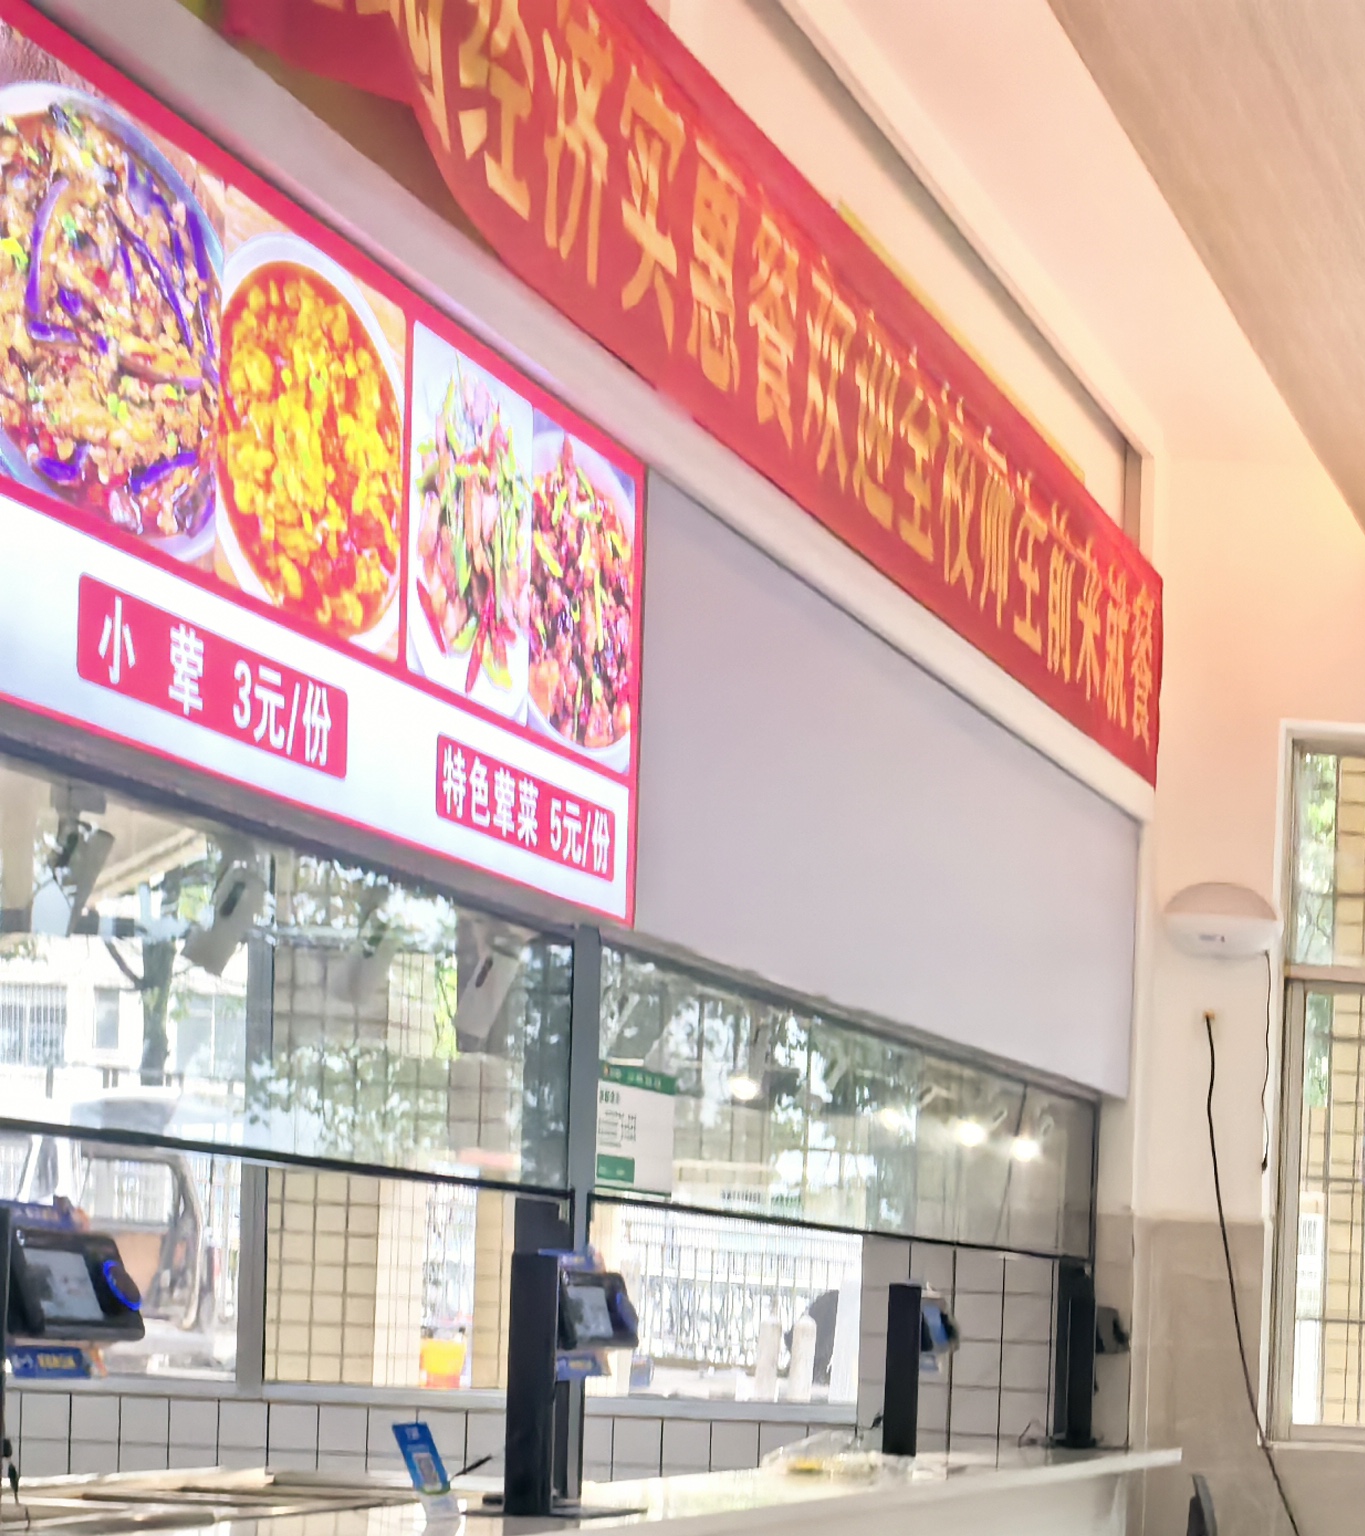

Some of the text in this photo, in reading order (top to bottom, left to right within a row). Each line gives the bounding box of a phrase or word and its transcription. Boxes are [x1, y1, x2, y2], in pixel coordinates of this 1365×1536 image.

[98, 595, 332, 767] 小 荤 3元/份
[442, 744, 611, 874] 特色荤菜 5元/份
